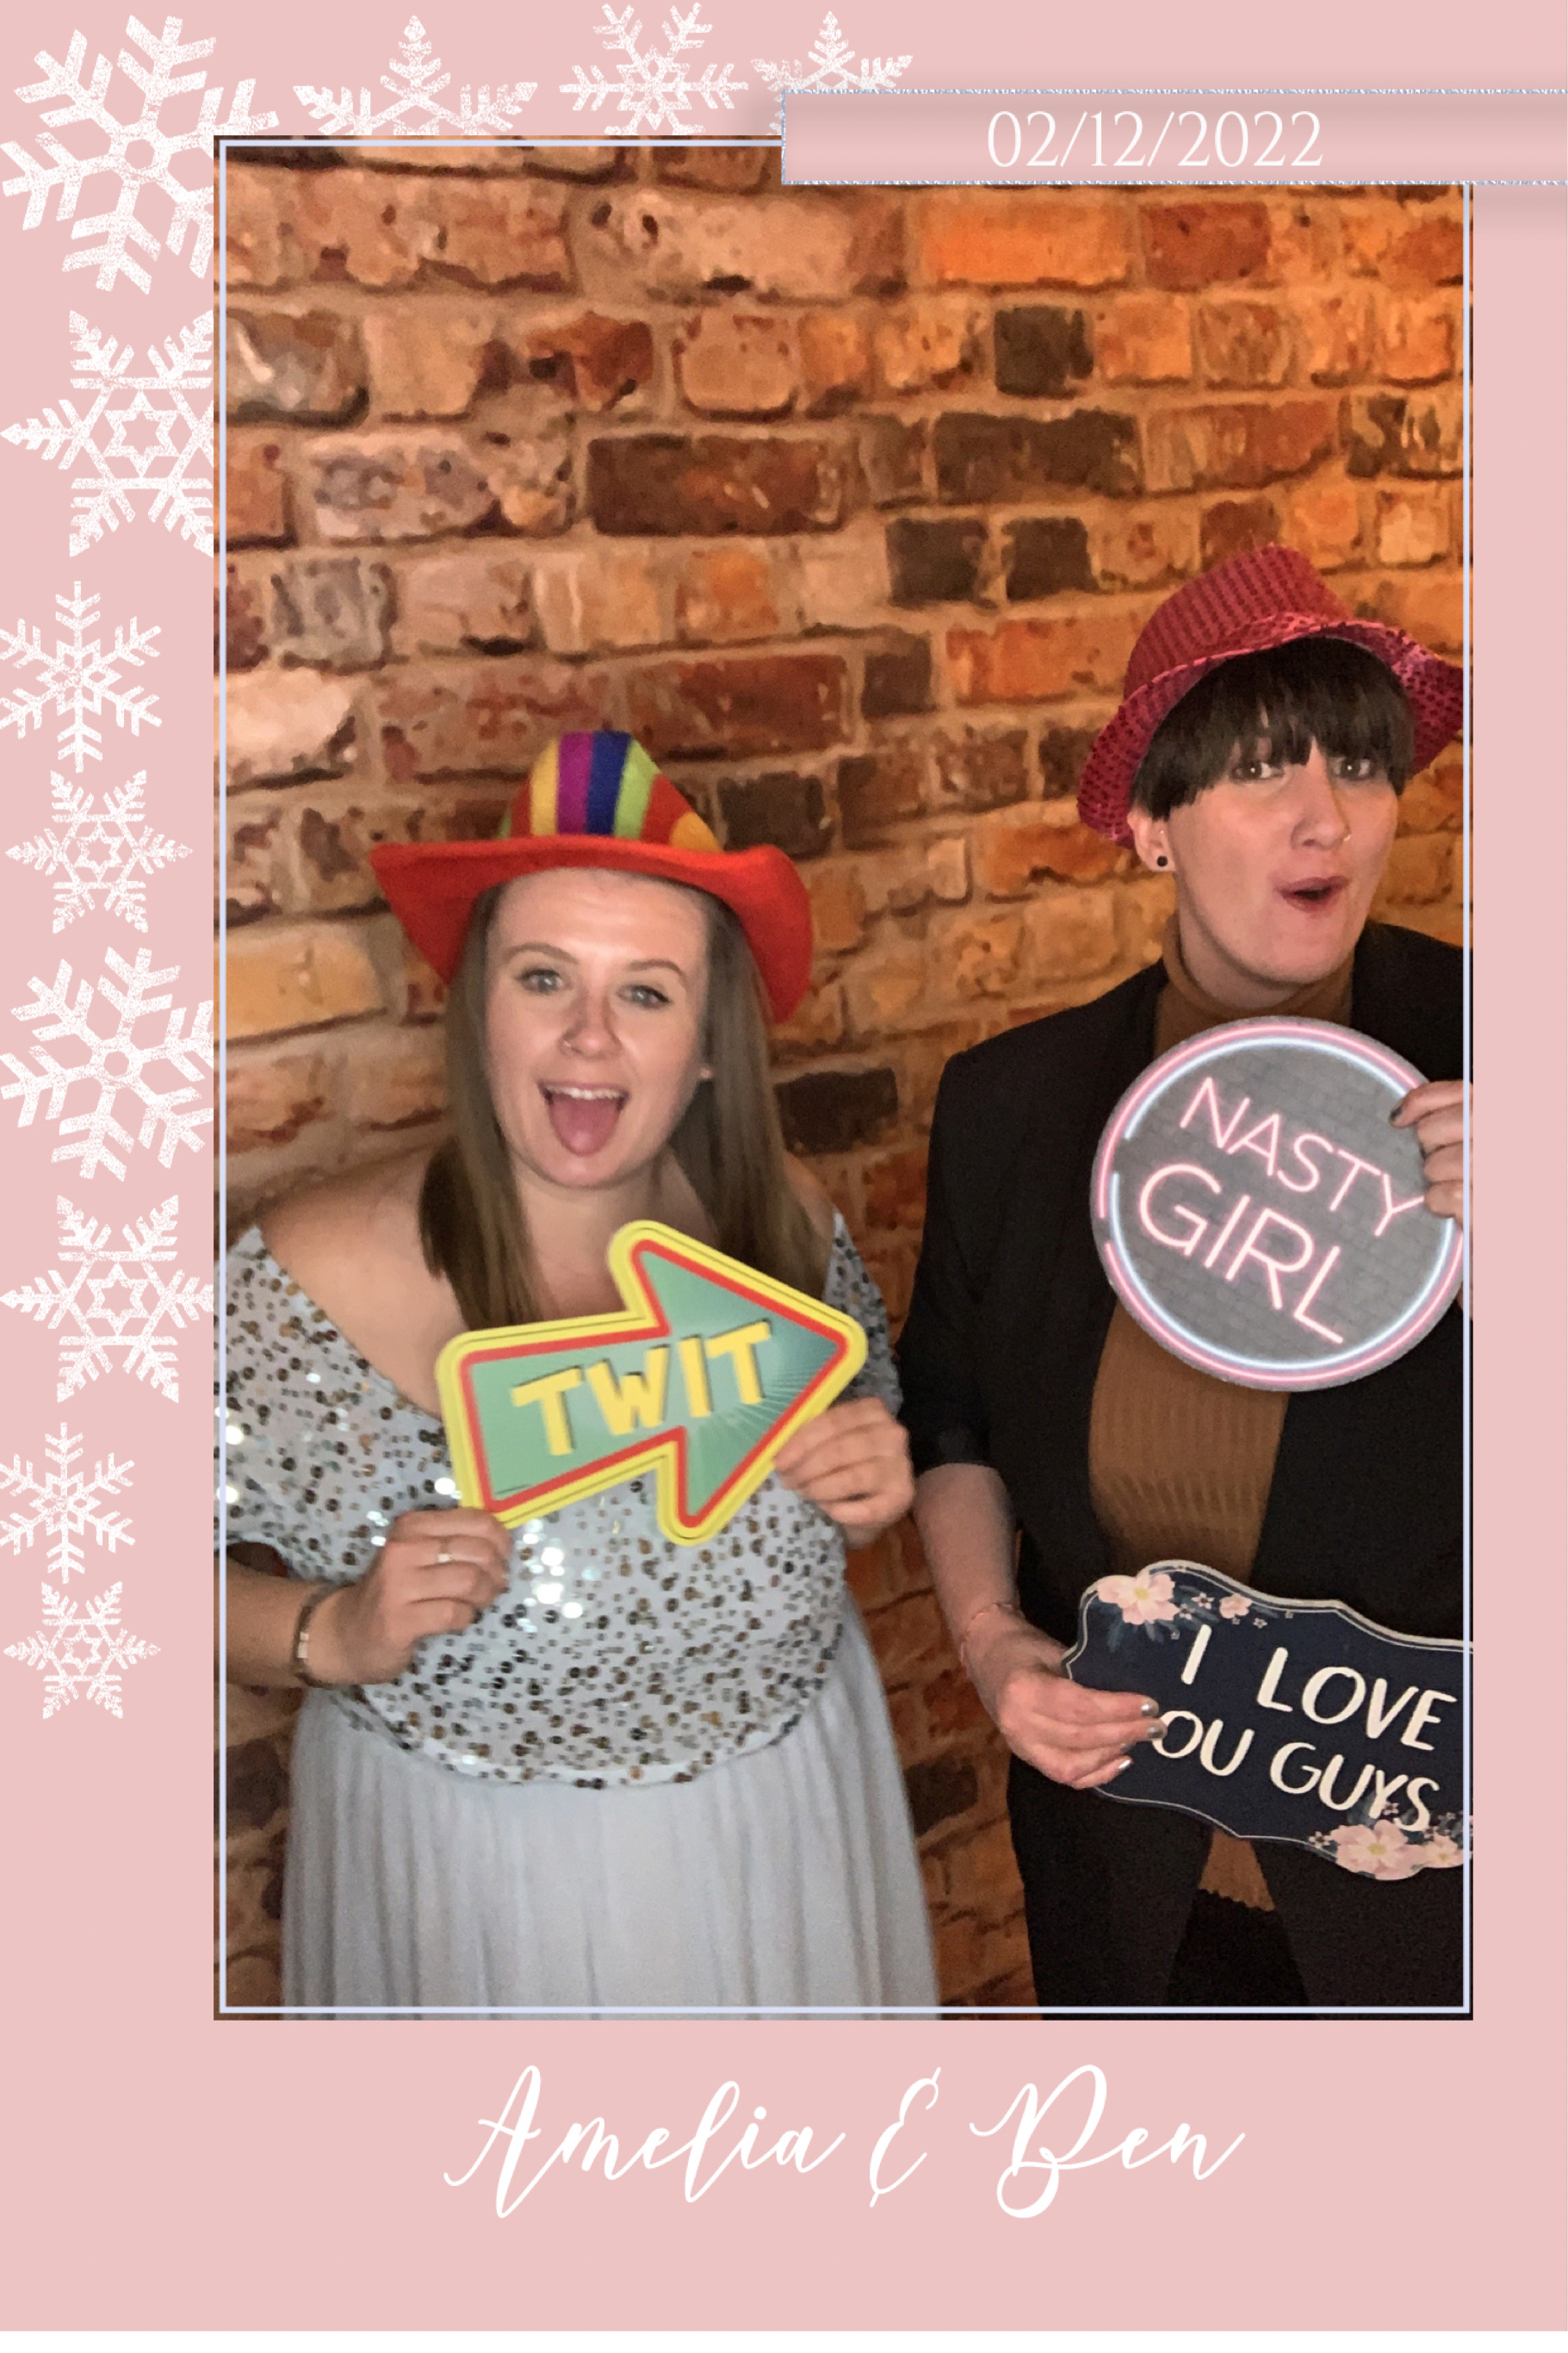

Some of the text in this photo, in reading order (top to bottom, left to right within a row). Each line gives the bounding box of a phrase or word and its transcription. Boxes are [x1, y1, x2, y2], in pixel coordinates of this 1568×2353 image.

[1178, 1076, 1425, 1238] NASTY
[1138, 1163, 1345, 1344] GIRL
[510, 1319, 772, 1457] TWIT
[1181, 1624, 1458, 1752] I LOVE
[1150, 1710, 1441, 1832] OU GUYS
